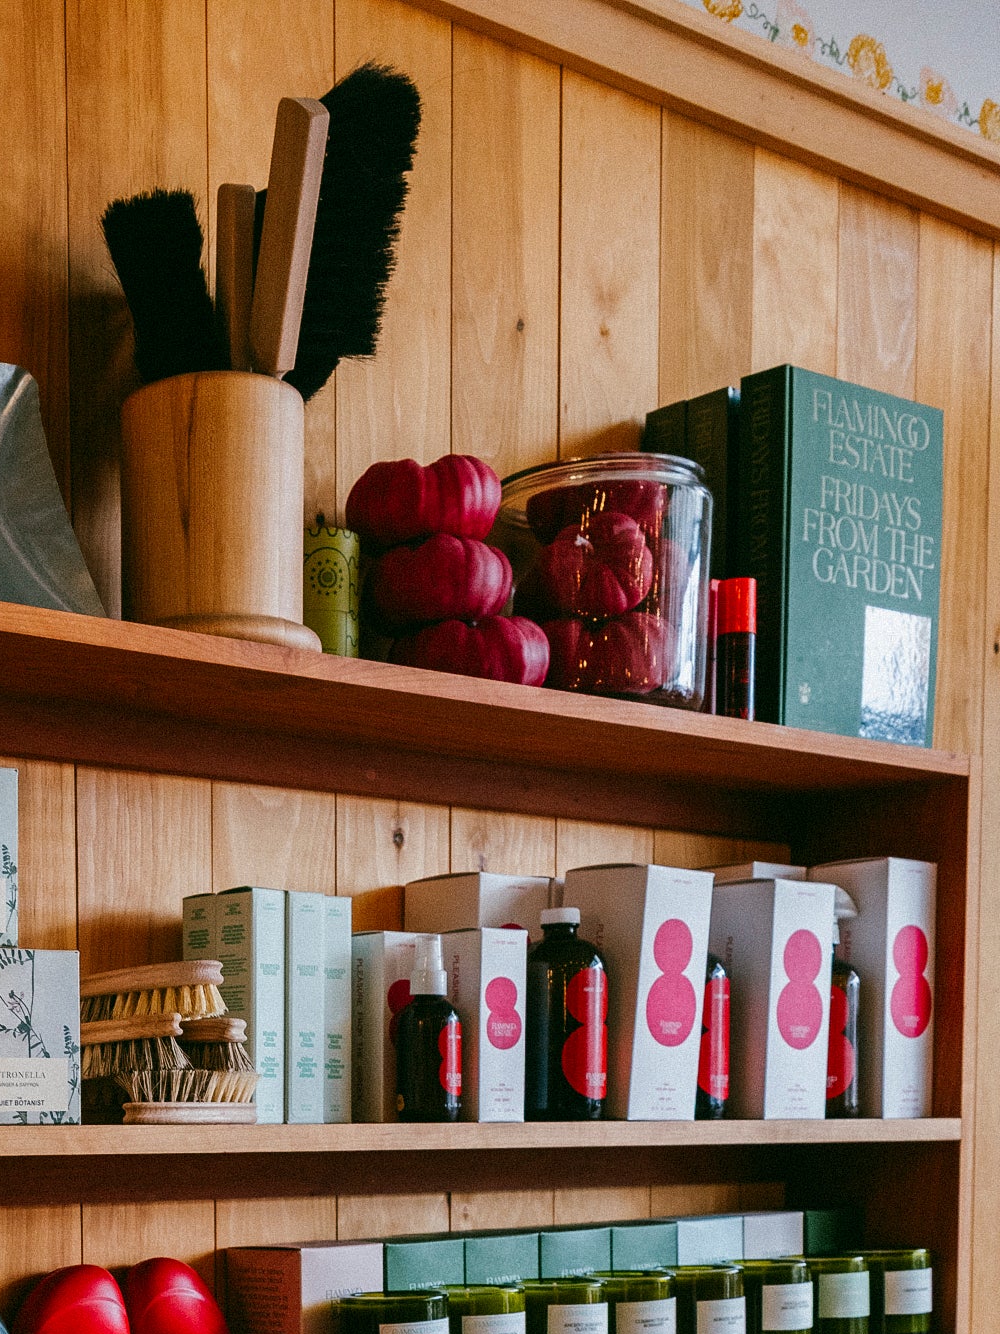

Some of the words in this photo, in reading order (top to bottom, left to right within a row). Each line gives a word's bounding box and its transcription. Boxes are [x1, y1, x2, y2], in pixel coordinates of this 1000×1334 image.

[811, 388, 930, 452] FLAMINGO
[828, 429, 915, 484] ESTATE
[820, 475, 922, 532] FRIDAYS
[802, 507, 882, 561] FROM
[885, 526, 936, 571] THE
[811, 549, 925, 602] GARDEN
[14, 1099, 45, 1107] BOTANIST
